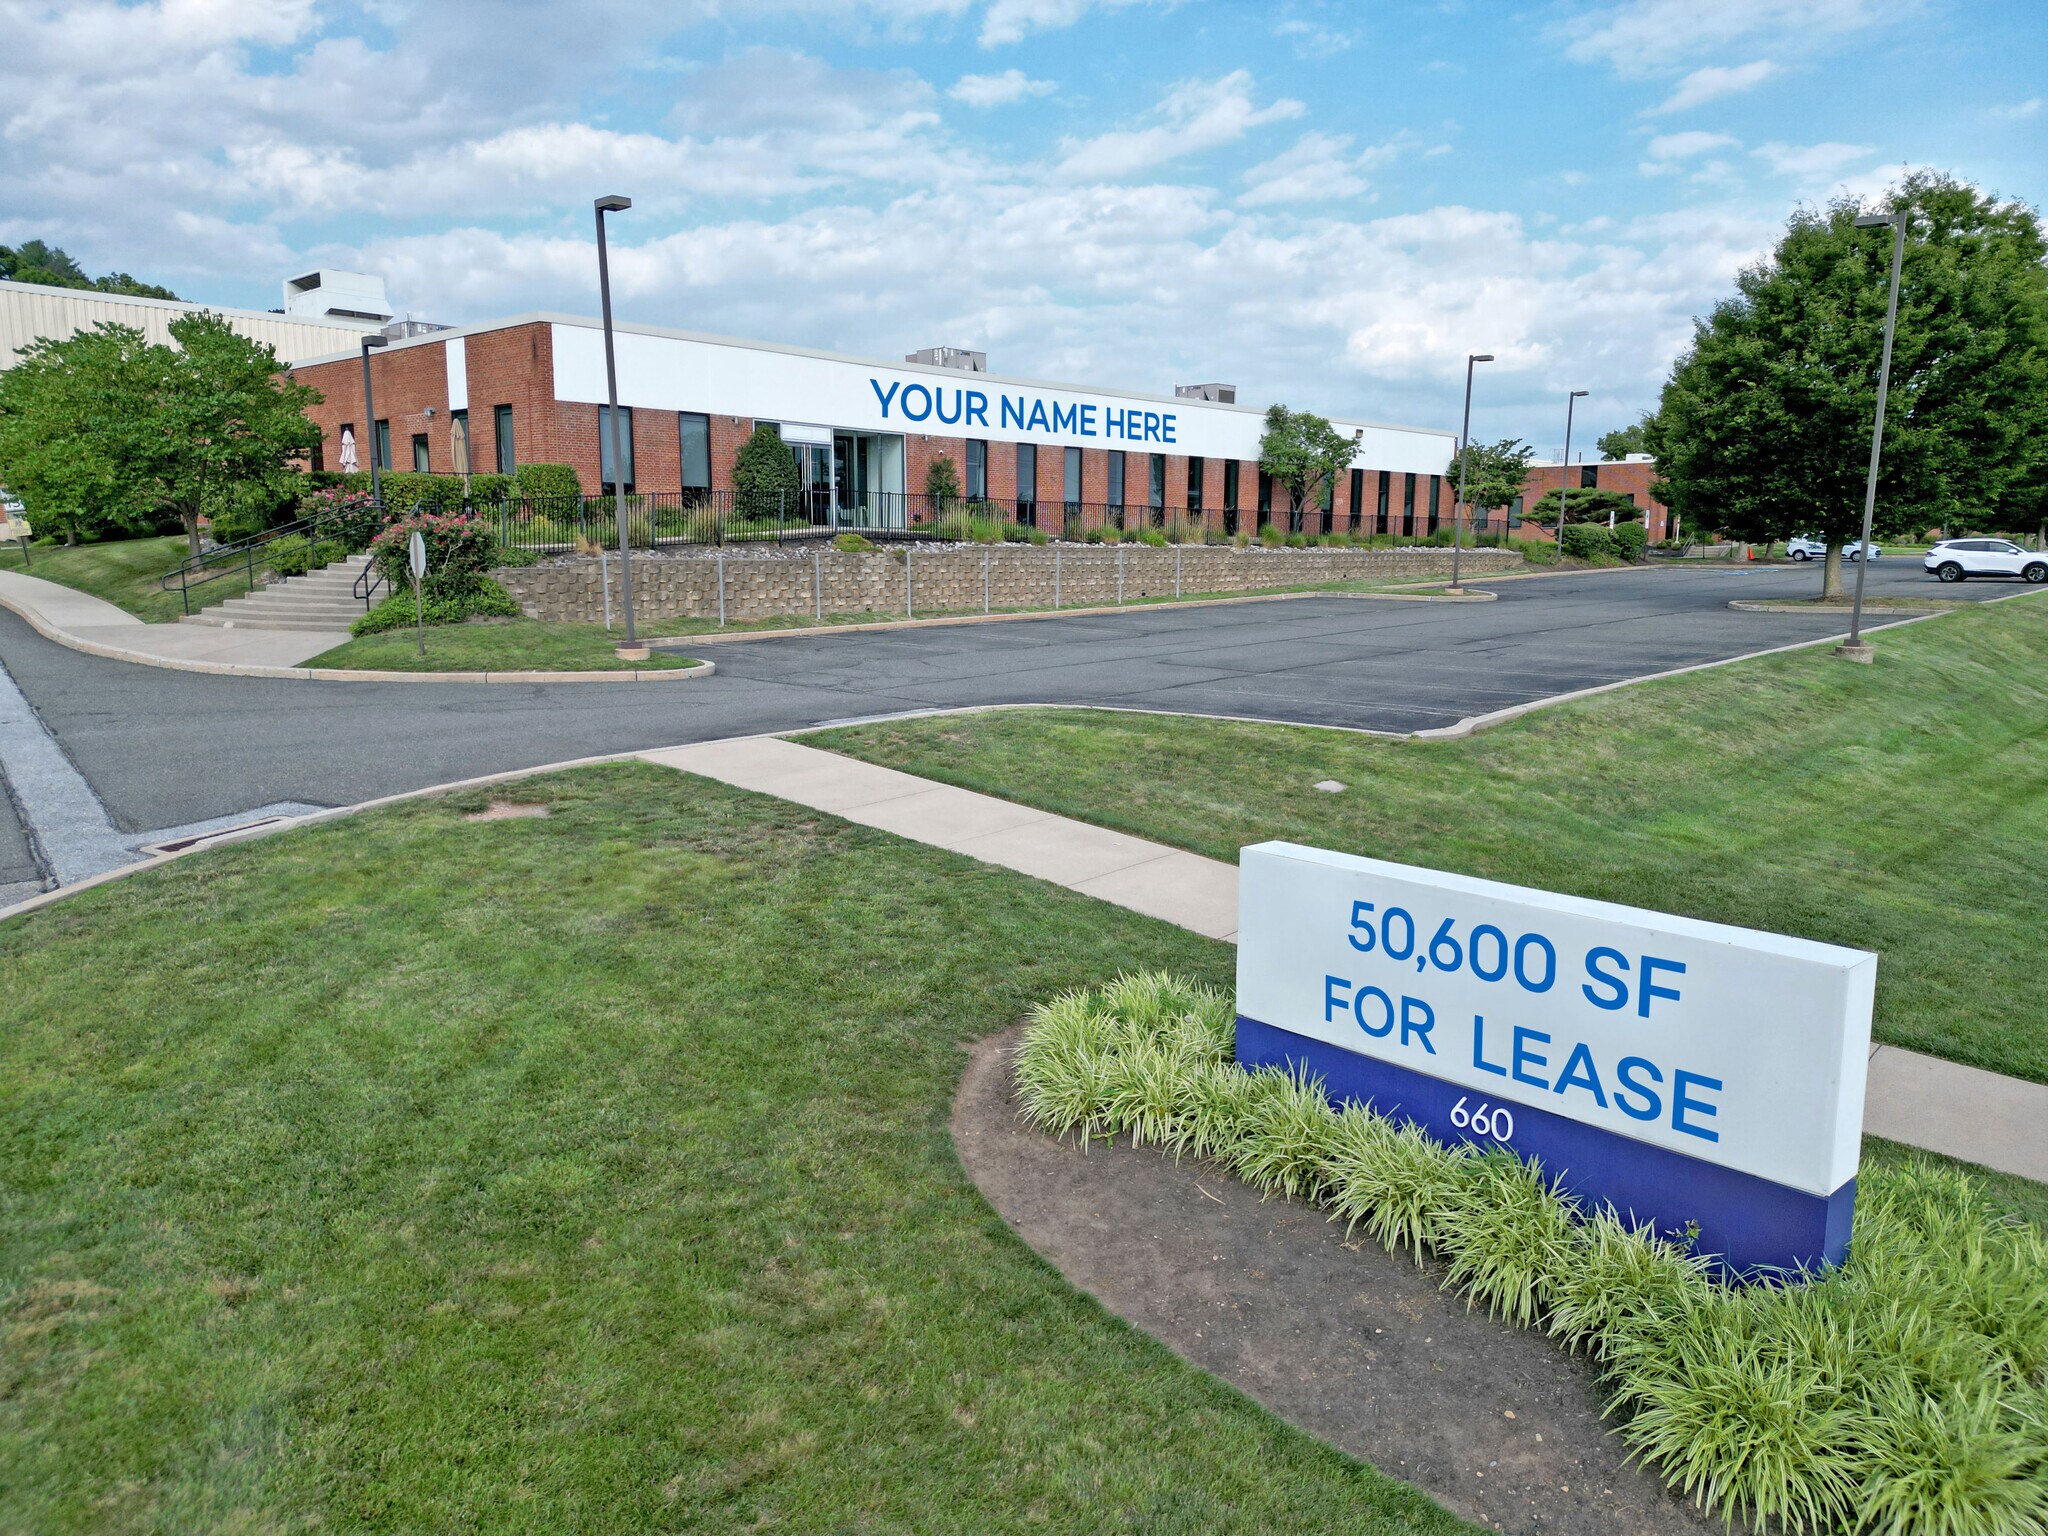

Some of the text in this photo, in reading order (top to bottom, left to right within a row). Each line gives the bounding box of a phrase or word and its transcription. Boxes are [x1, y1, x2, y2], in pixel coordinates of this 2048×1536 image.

[869, 378, 1177, 444] YOUR NAME HERE
[1347, 899, 1687, 1019] 50,600 SF
[1325, 974, 1723, 1144] FOR LEASE
[1450, 1096, 1514, 1142] 660
